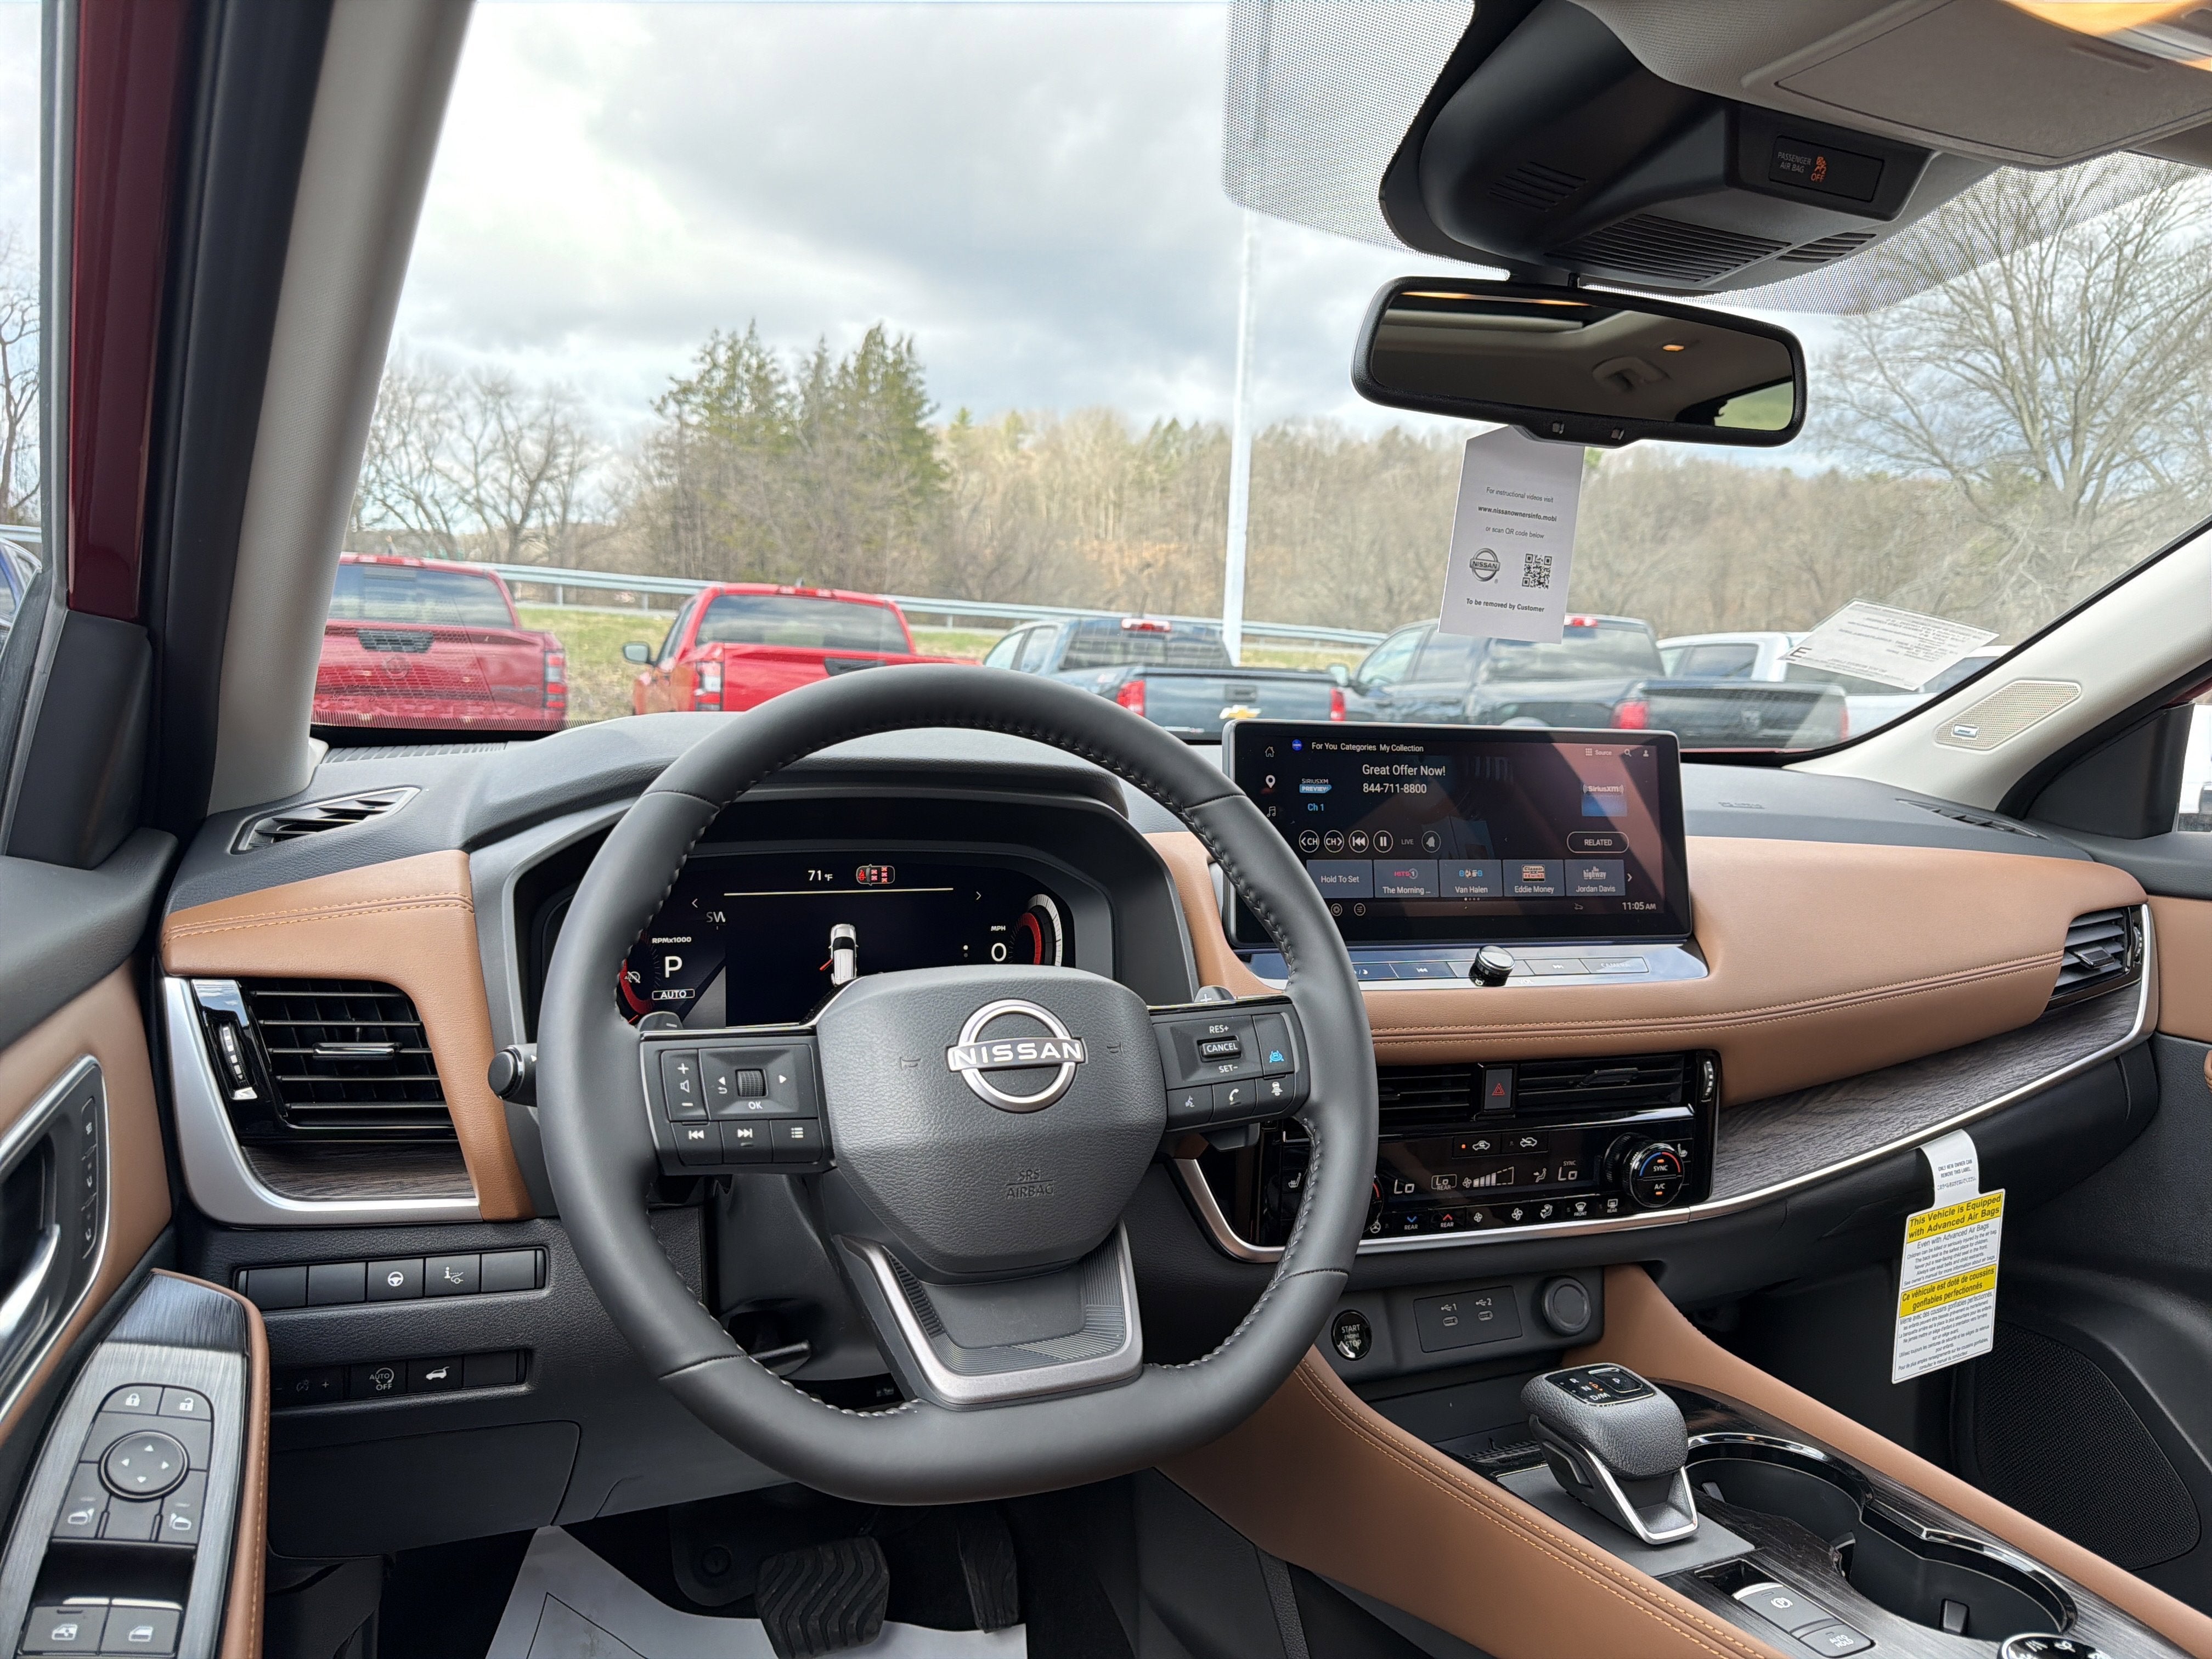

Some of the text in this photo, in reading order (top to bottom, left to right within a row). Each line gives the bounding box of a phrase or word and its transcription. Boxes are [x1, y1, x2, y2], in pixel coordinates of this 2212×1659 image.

[1778, 152, 1812, 165] PASSENGER
[1792, 164, 1804, 173] BAG
[1810, 173, 1825, 182] OFF
[1478, 506, 1557, 521] www.nissanownersinfo.mobi
[1483, 600, 1507, 608] removed
[1509, 602, 1515, 611] by
[1517, 604, 1544, 612] Customer
[1340, 743, 1376, 752] Categories
[1380, 744, 1390, 753] My
[1362, 764, 1446, 776] Great Offer Now!
[1363, 783, 1427, 794] 844-711-8800
[1320, 803, 1324, 811] 1
[1583, 870, 1606, 880] highway
[1397, 887, 1424, 895] Morning
[1533, 885, 1555, 894] Money
[1622, 902, 1645, 911] 11:05
[991, 943, 1006, 961] 0
[665, 956, 682, 978] P
[1209, 1025, 1229, 1034] RES+
[954, 1042, 1081, 1064] NISSAN
[1207, 1043, 1238, 1053] CANCEL
[748, 1101, 763, 1109] OK
[1018, 1169, 1041, 1181] SRS
[1558, 1166, 1578, 1181] Lo
[1436, 1176, 1449, 1186] Lo
[1006, 1184, 1054, 1199] AIRBAG
[1393, 1179, 1415, 1194] Lo
[1910, 1194, 2001, 1227] This Vehicle is Equipped
[1909, 1207, 2000, 1238] with Advanced Air Bags
[1917, 1240, 1930, 1249] Even
[1942, 1228, 1967, 1242] Advanced
[1976, 1223, 1989, 1232] Bags
[1902, 1268, 1994, 1301] Ce véhicule est doté de coussins
[1912, 1282, 1982, 1311] gonflables perfectionnés
[1341, 1324, 1361, 1333] START
[1589, 1392, 1611, 1401] D/M
[1829, 1634, 1848, 1644] AUTO
[1835, 1638, 1854, 1648] HOLD
